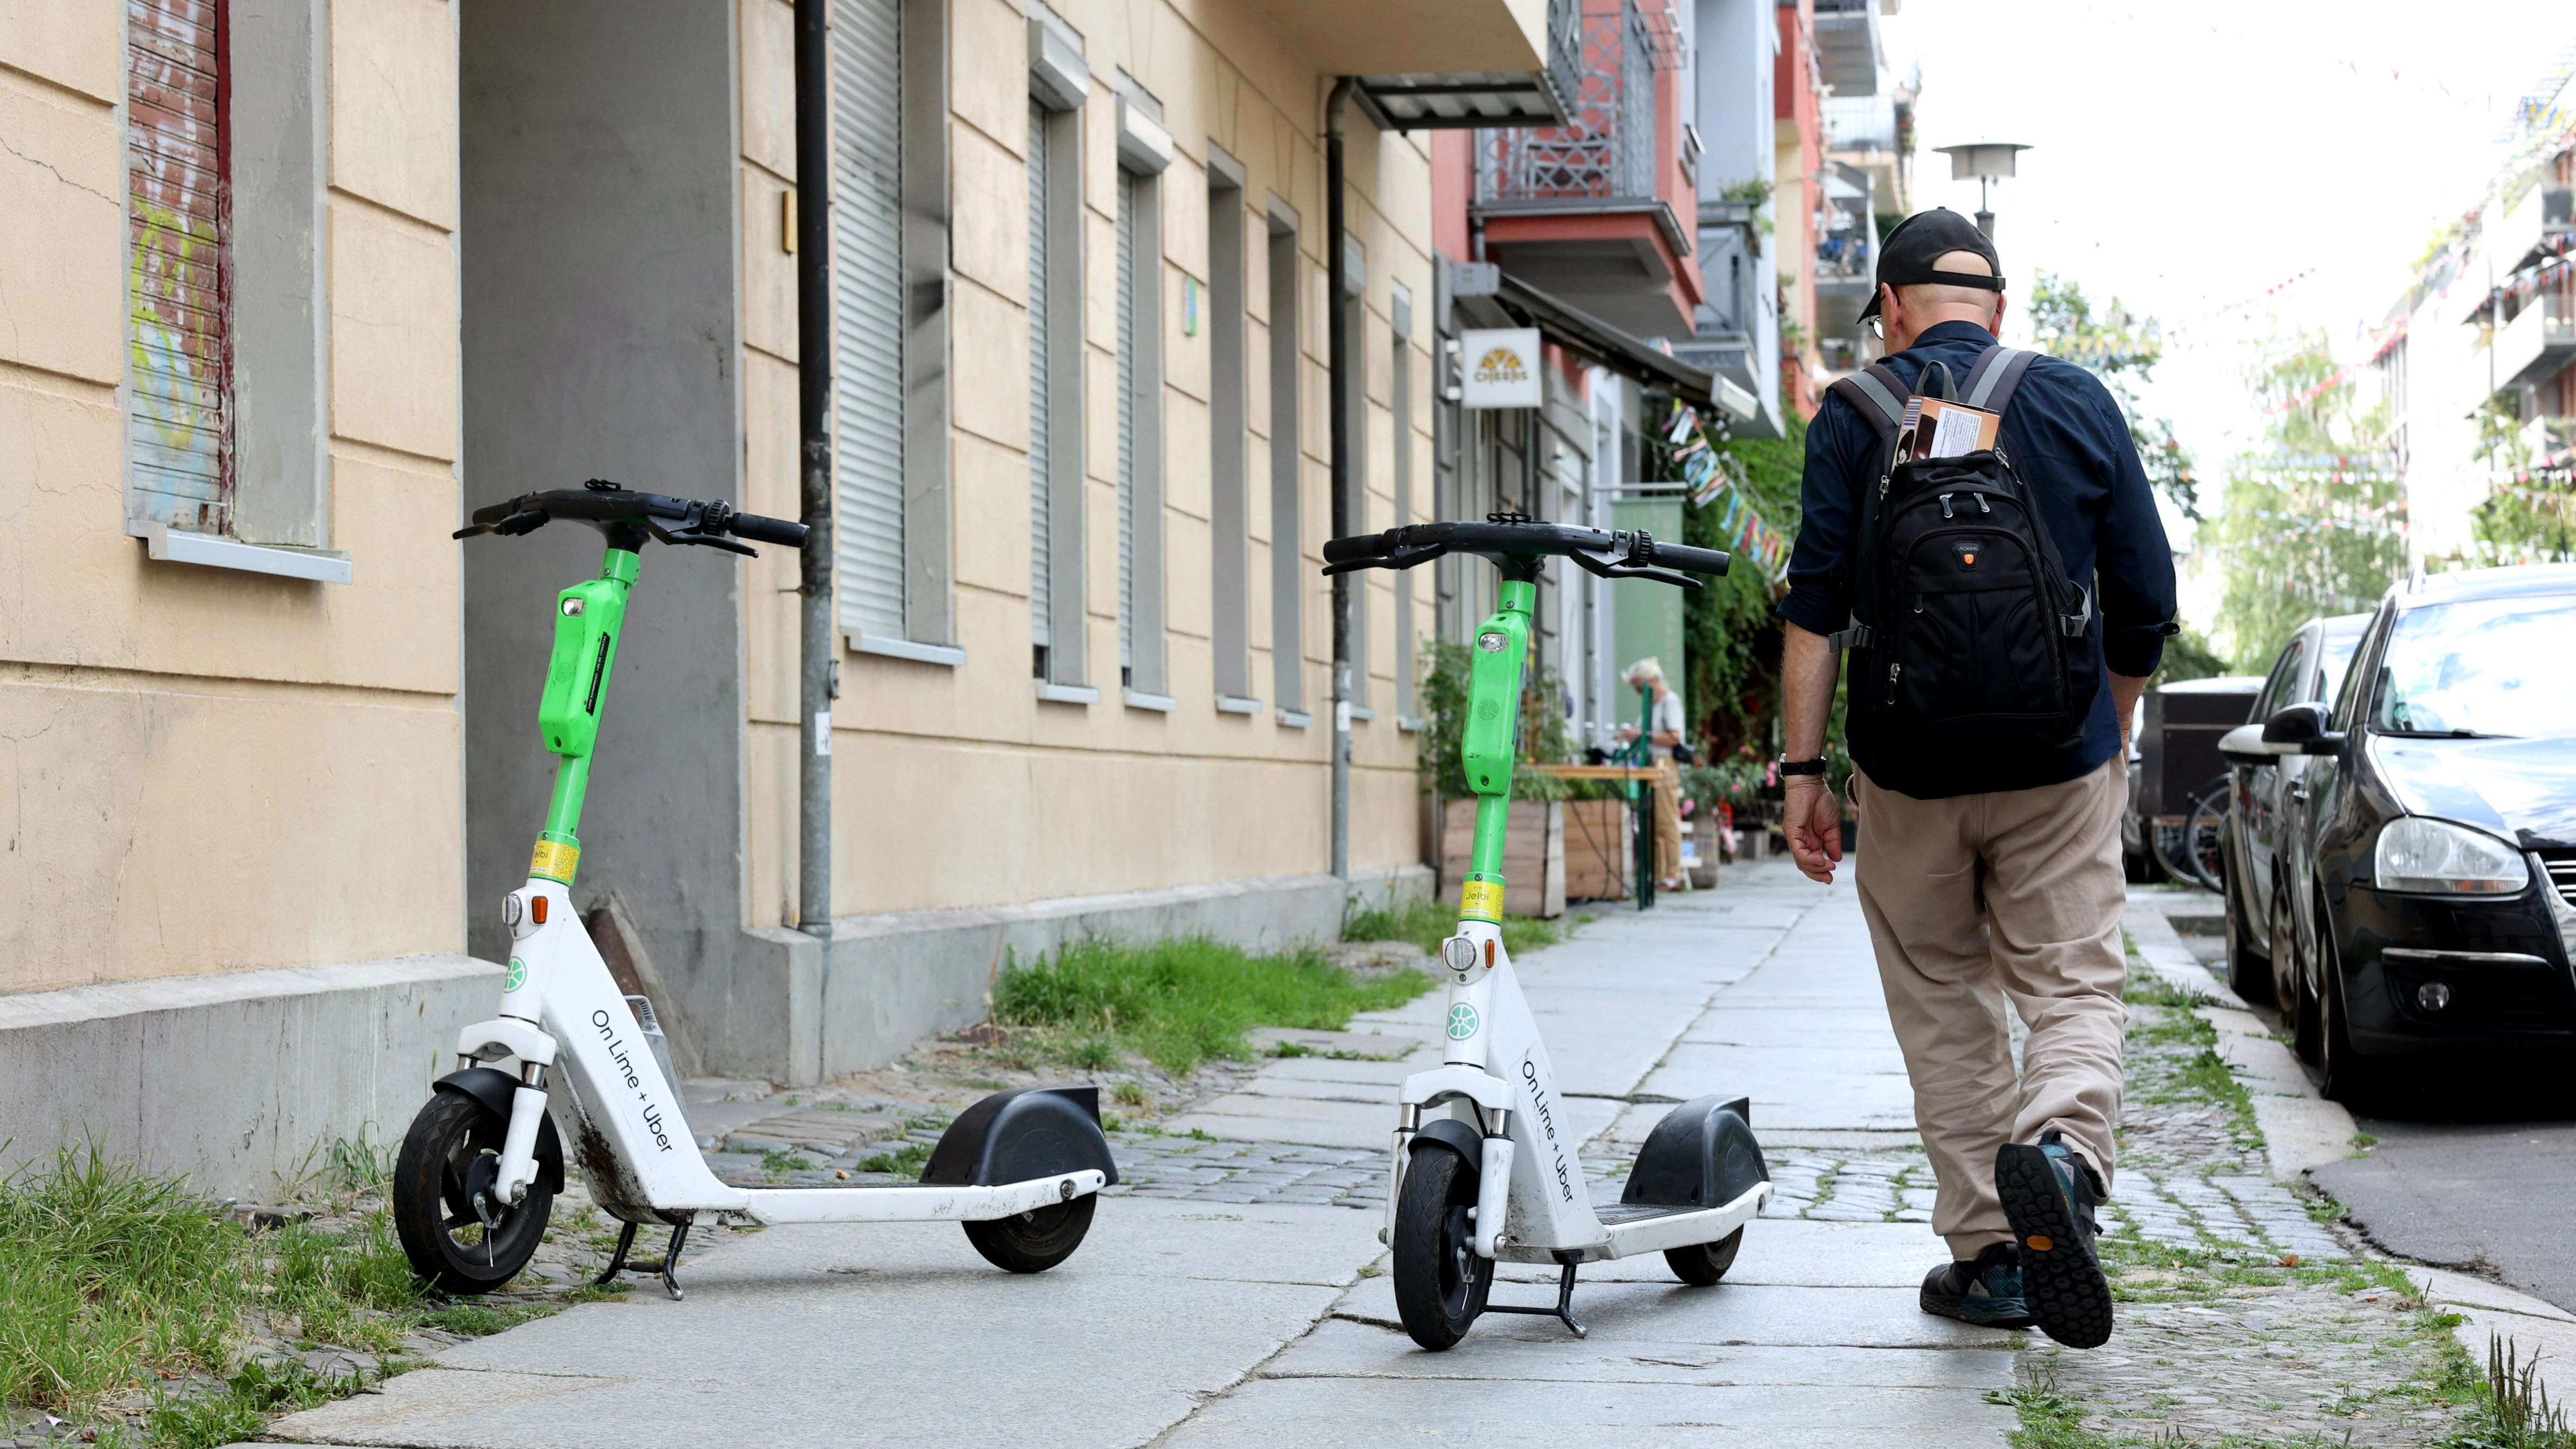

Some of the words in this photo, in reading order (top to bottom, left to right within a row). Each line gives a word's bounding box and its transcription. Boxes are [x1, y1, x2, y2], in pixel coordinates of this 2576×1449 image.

[534, 850, 548, 859] elbi
[1466, 891, 1489, 901] Jelbi
[593, 1010, 613, 1041] On
[608, 1040, 638, 1089] Lime
[639, 1092, 647, 1102] +
[643, 1104, 672, 1152] Uber
[1523, 1061, 1538, 1093] On
[1535, 1090, 1555, 1141] Lime
[1553, 1143, 1559, 1153] +
[1555, 1153, 1574, 1203] Uber
